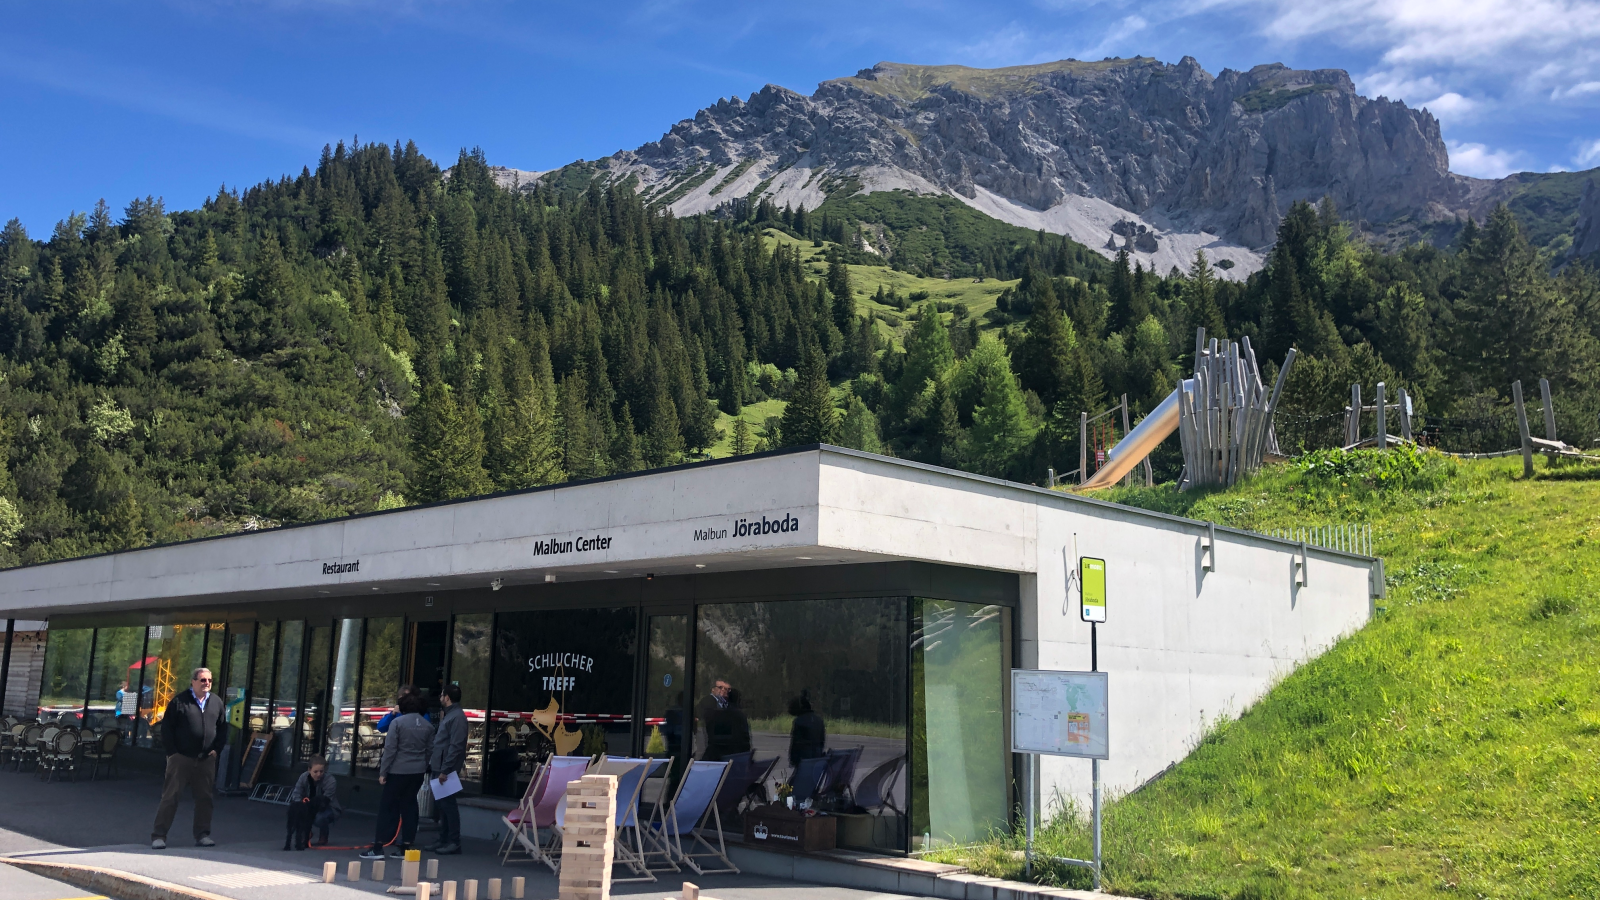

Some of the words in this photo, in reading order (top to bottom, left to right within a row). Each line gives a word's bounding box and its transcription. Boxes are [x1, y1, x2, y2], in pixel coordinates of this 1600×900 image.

[693, 527, 727, 541] Malbun
[732, 512, 799, 538] Jöraboda
[533, 538, 573, 556] Malbun
[575, 534, 613, 552] Center
[322, 559, 360, 575] Restaurant
[528, 652, 594, 673] SCHLUCHER
[542, 676, 575, 691] TREFF
